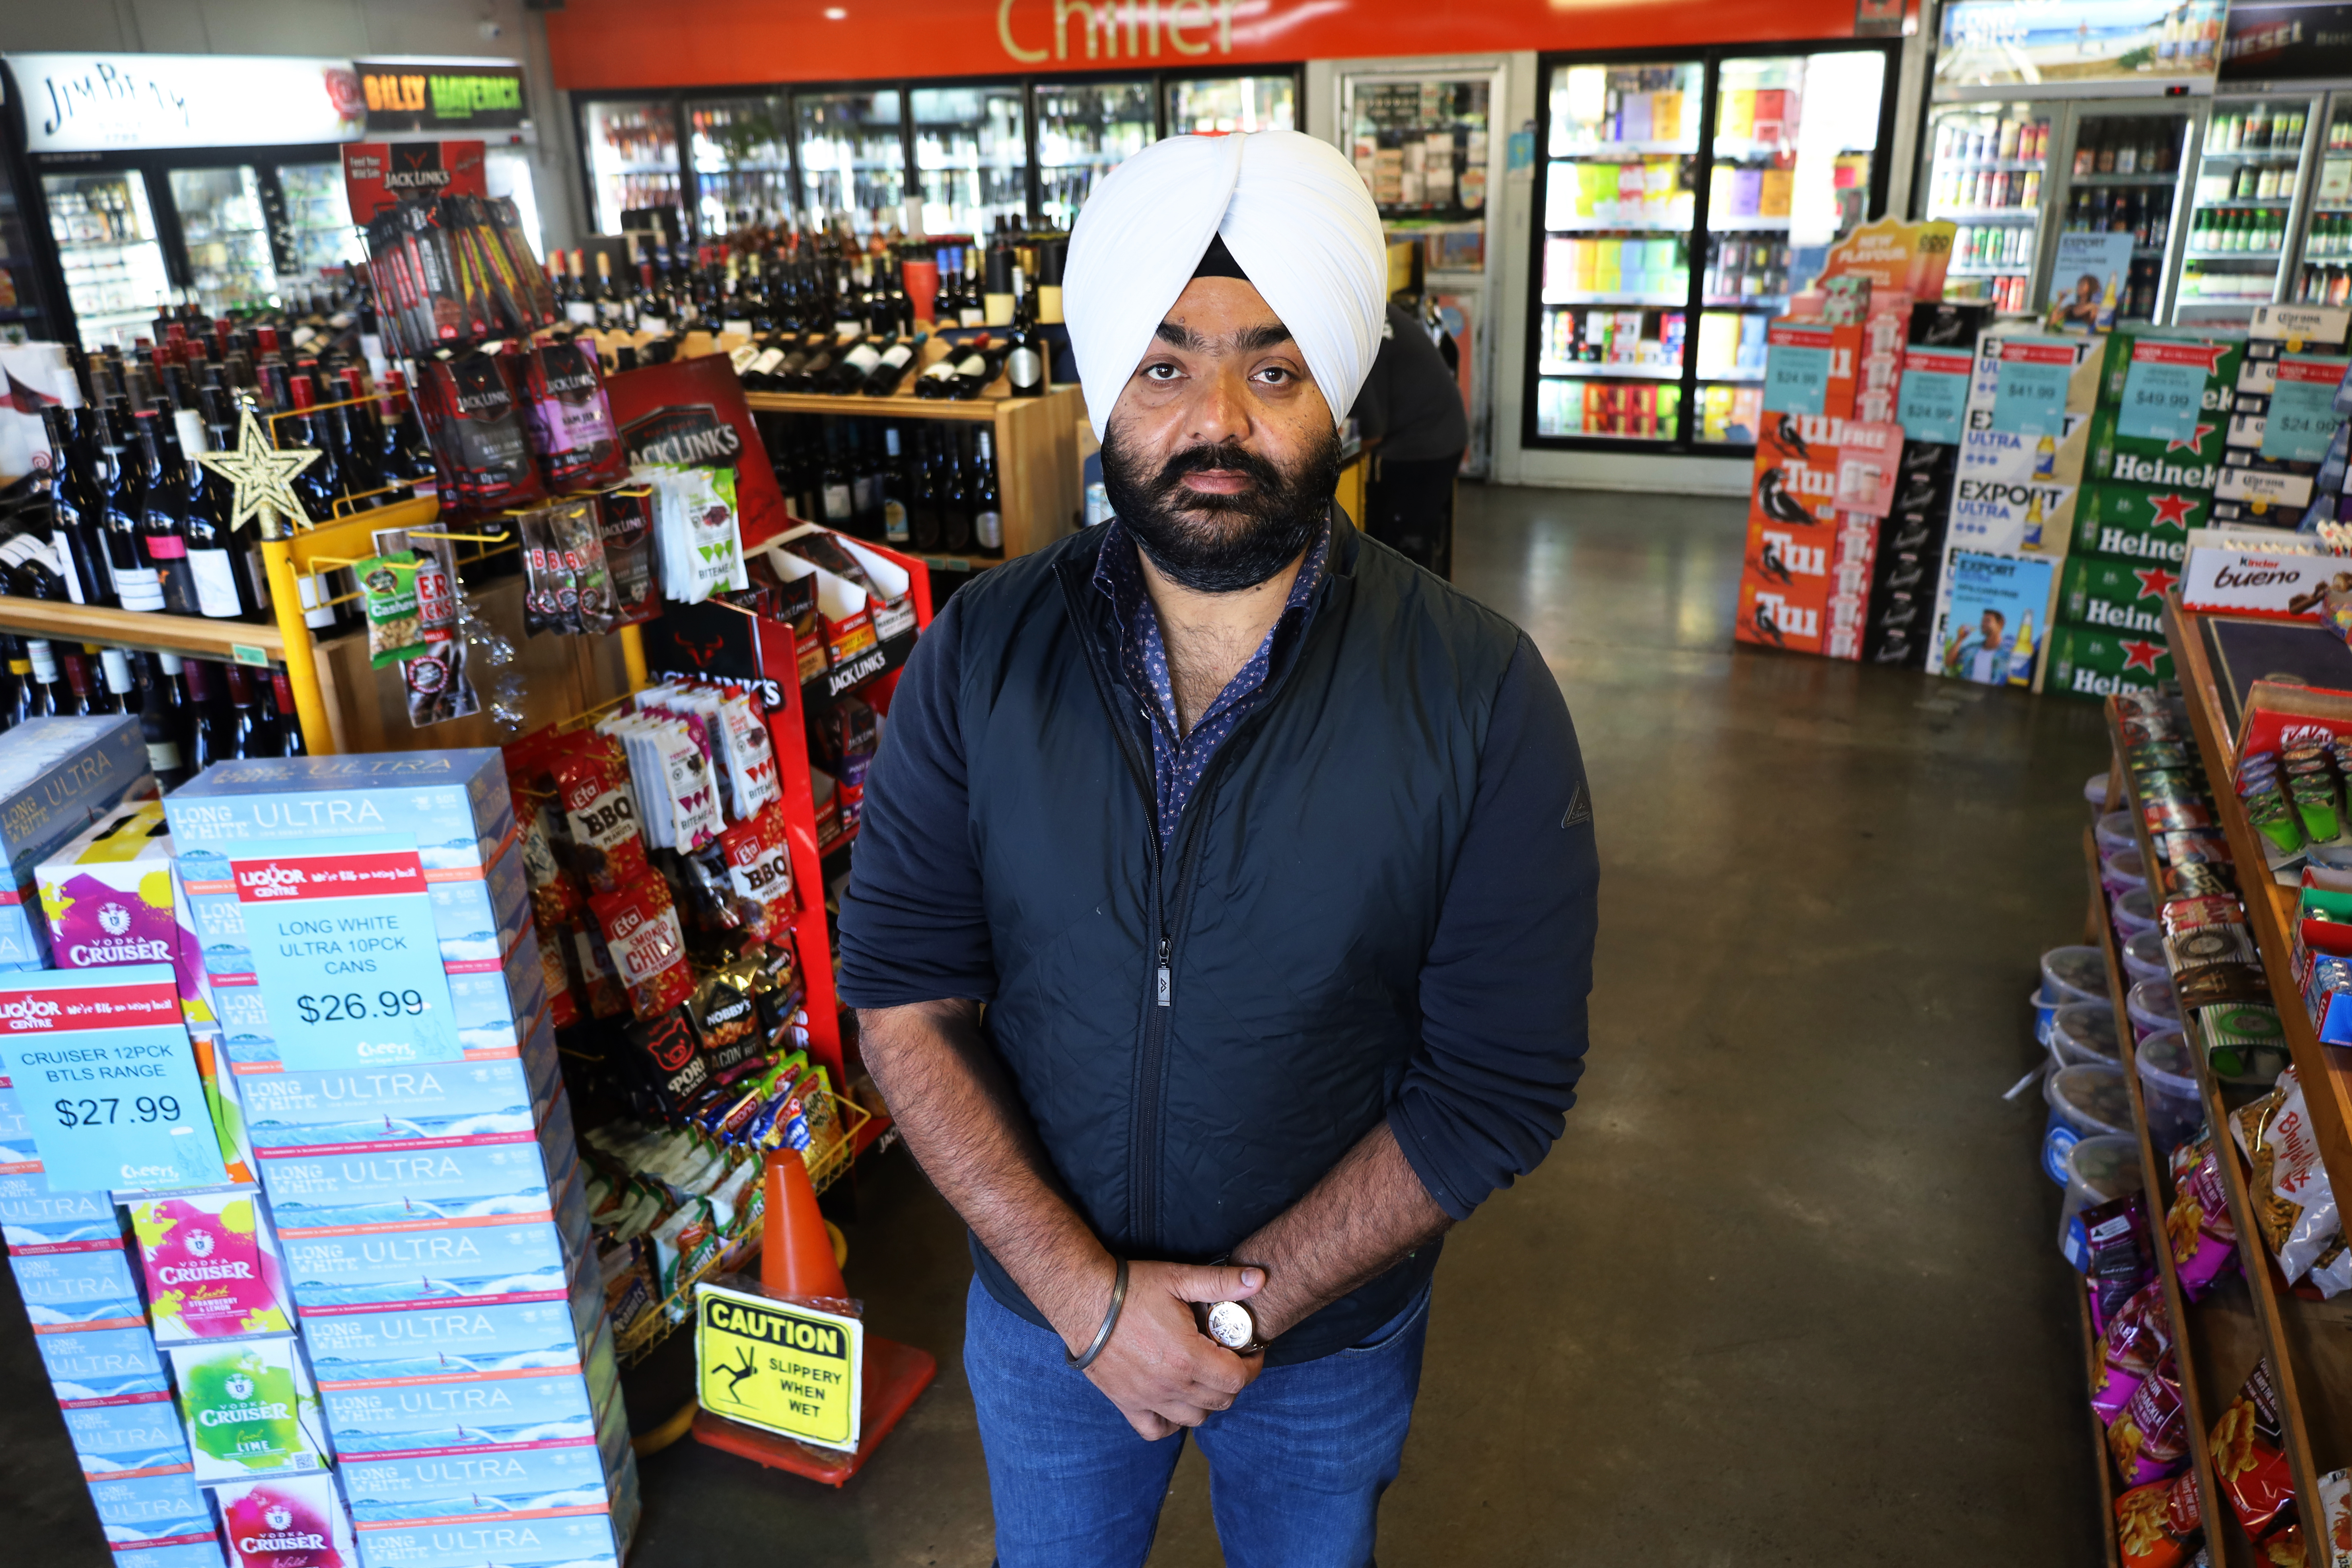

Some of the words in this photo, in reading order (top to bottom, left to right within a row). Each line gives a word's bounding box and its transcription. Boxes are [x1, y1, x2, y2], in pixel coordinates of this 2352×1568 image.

[998, 0, 1231, 64] Chiller
[384, 171, 414, 189] JACK
[630, 441, 679, 465] ACK
[677, 423, 739, 463] LINK'S
[1842, 426, 1885, 448] FREE
[1968, 432, 2022, 449] ULTRA
[1782, 459, 1835, 497] Tui
[1957, 501, 2010, 519] ULTRA
[1763, 530, 1826, 576] Tui
[1960, 559, 2017, 577] EXPORT
[2214, 566, 2300, 589] bueno
[416, 574, 450, 601] ER
[1755, 591, 1818, 637] Tui
[829, 669, 858, 696] JACK
[852, 651, 886, 680] LINK'S
[45, 750, 112, 806] ULTRA
[573, 783, 597, 809] Eta
[0, 796, 38, 830] LONG
[173, 806, 232, 824] LONG
[253, 798, 384, 829] ULTRA
[578, 796, 634, 838] BBQ
[6, 806, 49, 844] WHITE
[177, 821, 249, 840] WHITE
[604, 823, 633, 845] PEANUTS
[739, 844, 759, 864] Eta
[239, 868, 307, 887] LIQUOR
[310, 871, 338, 883] We're
[395, 866, 417, 878] local
[741, 856, 788, 891] BBQ
[254, 886, 299, 898] CENTRE
[199, 903, 242, 919] LON
[203, 919, 246, 934] WHI
[278, 919, 333, 936] LONG
[337, 915, 400, 932] WHITE
[614, 912, 639, 936] Eta
[92, 936, 146, 947] VODKA
[628, 921, 669, 948] SMOKED
[70, 939, 175, 966] CRUISER
[279, 940, 343, 957] ULTRA
[349, 936, 408, 953] 10PCK
[324, 959, 377, 975] CANS
[66, 1004, 93, 1015] We're
[93, 1002, 113, 1014] BIG
[126, 1001, 151, 1013] being
[151, 998, 173, 1010] local
[222, 994, 264, 1011] LON
[297, 989, 423, 1025] $26.99
[9, 1018, 54, 1030] CENTRE
[226, 1010, 270, 1025] WHI
[21, 1048, 109, 1066] CRUISER
[113, 1044, 174, 1060] 12PCK
[357, 1041, 416, 1058] Cheers,
[46, 1068, 95, 1082] BTLS
[99, 1064, 167, 1079] RANGE
[245, 1080, 302, 1097] LONG
[320, 1072, 445, 1101] ULTRA
[55, 1095, 181, 1129] $27.99
[249, 1095, 318, 1112] WHITE
[121, 1164, 179, 1179] Cheers,
[268, 1164, 324, 1181] LONG
[342, 1156, 463, 1183] ULTRA
[271, 1177, 339, 1194] WHITE
[0, 1197, 98, 1218] ULTRA
[290, 1244, 344, 1261] LONG
[362, 1236, 481, 1263] ULTRA
[19, 1260, 51, 1271] LONG
[159, 1261, 255, 1285] CRUISER
[179, 1258, 230, 1268] VODKA
[294, 1257, 359, 1274] WHITE
[24, 1276, 119, 1297] ULTRA
[188, 1297, 238, 1308] STRAWBERRY
[308, 1321, 362, 1338] LONG
[379, 1314, 496, 1340] ULTRA
[710, 1302, 838, 1355] CAUTION
[46, 1338, 78, 1350] LONG
[311, 1334, 377, 1350] WHITE
[51, 1353, 145, 1373] ULTRA
[768, 1357, 842, 1385] SLIPPERY
[780, 1378, 825, 1401] WHEN
[219, 1401, 268, 1410] VODKA
[330, 1396, 382, 1411] LONG
[398, 1387, 513, 1413] ULTRA
[788, 1399, 821, 1418] WET
[72, 1413, 103, 1423] LONG
[200, 1403, 292, 1427] CRUISER
[334, 1407, 396, 1422] WHITE
[76, 1427, 169, 1447] ULTRA
[236, 1440, 270, 1452] LIME
[348, 1466, 399, 1482] LONG
[414, 1458, 527, 1483] ULTRA
[98, 1485, 128, 1494] LONG
[351, 1477, 413, 1494] WHITE
[101, 1498, 193, 1519] ULTRA
[240, 1533, 328, 1554] CRUISER
[366, 1535, 416, 1550] LONG
[432, 1527, 541, 1552] ULTRA
[370, 1546, 430, 1562] WHITE
